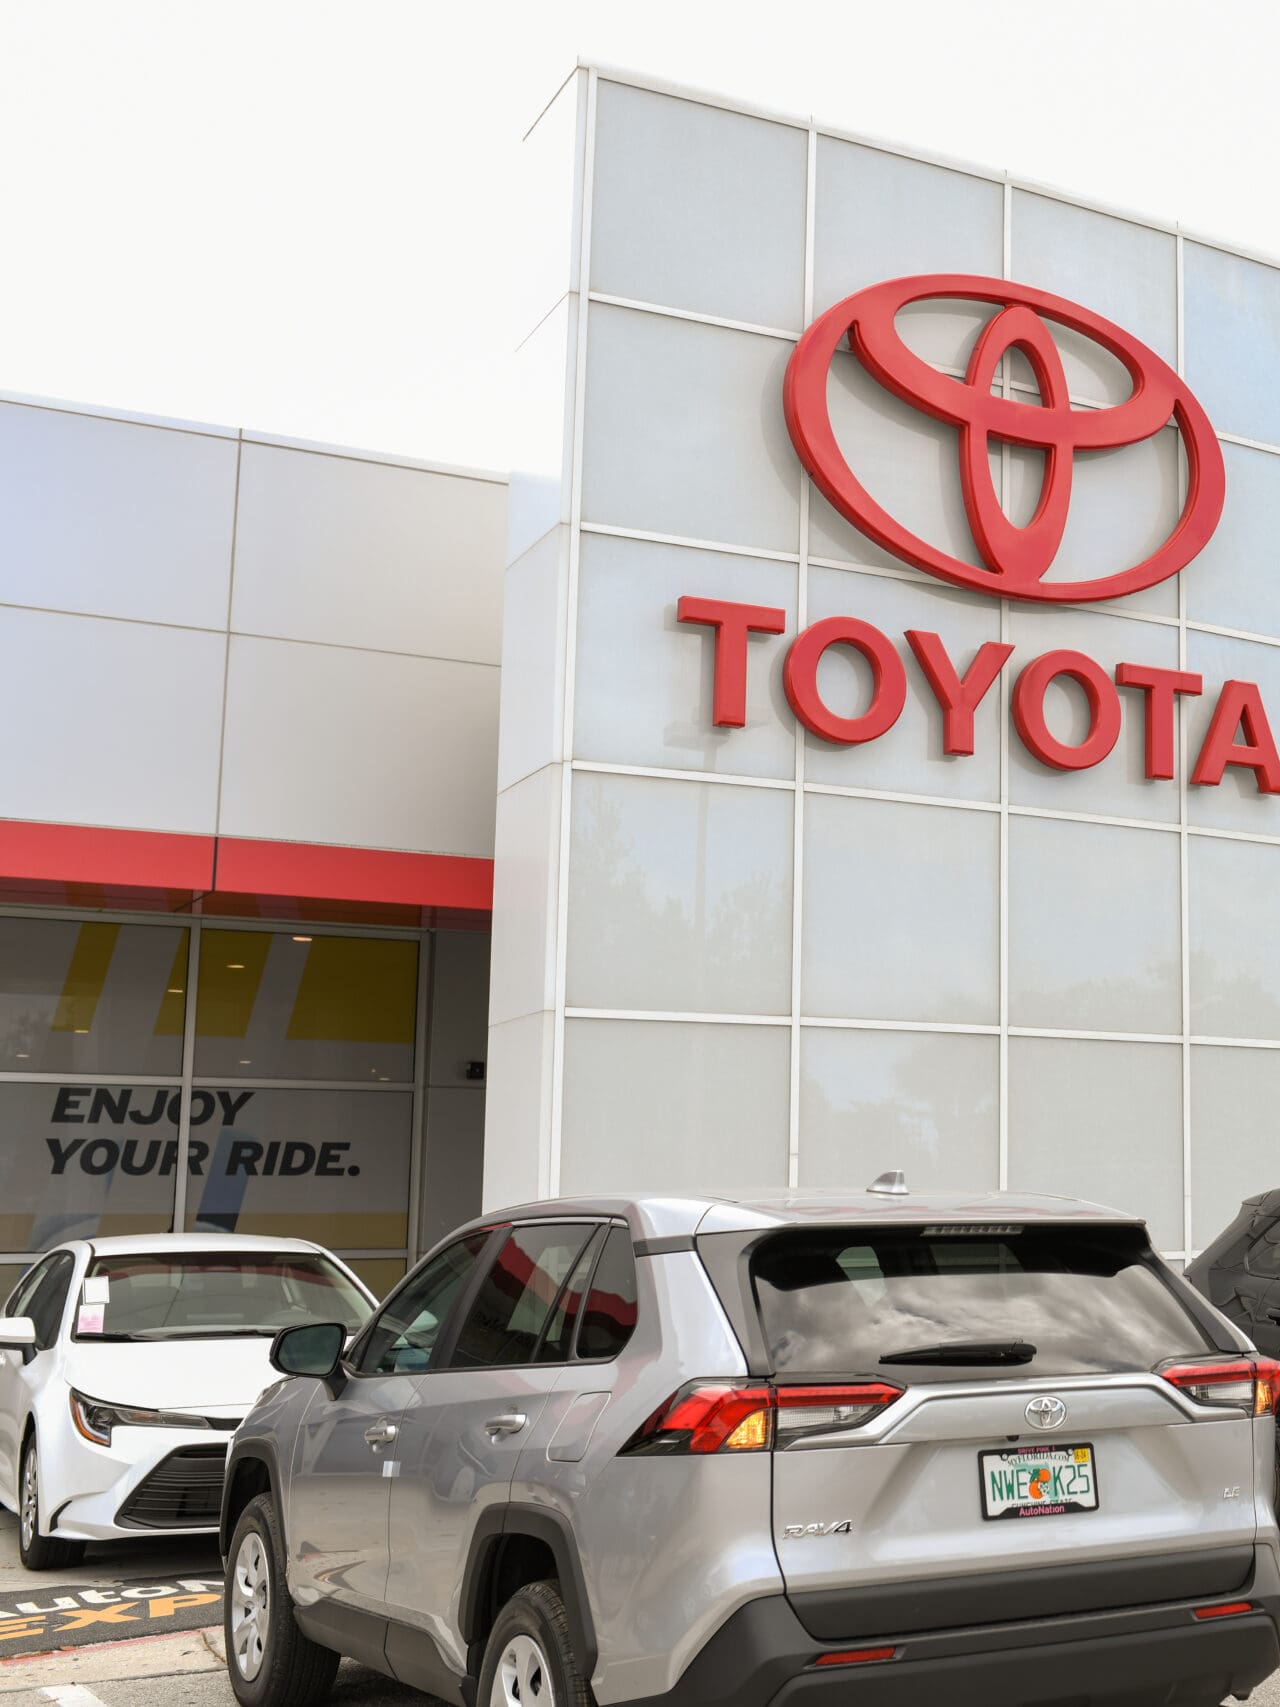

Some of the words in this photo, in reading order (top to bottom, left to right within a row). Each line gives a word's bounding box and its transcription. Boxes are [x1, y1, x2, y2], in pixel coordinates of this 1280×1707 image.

[51, 1087, 255, 1126] ENJOY
[46, 1138, 209, 1176] YOUR
[225, 1141, 361, 1177] RIDE.
[990, 1468, 1029, 1501] NWE
[1052, 1464, 1091, 1497] K25
[783, 1519, 852, 1539] RAV4
[1019, 1505, 1065, 1516] AutoNation
